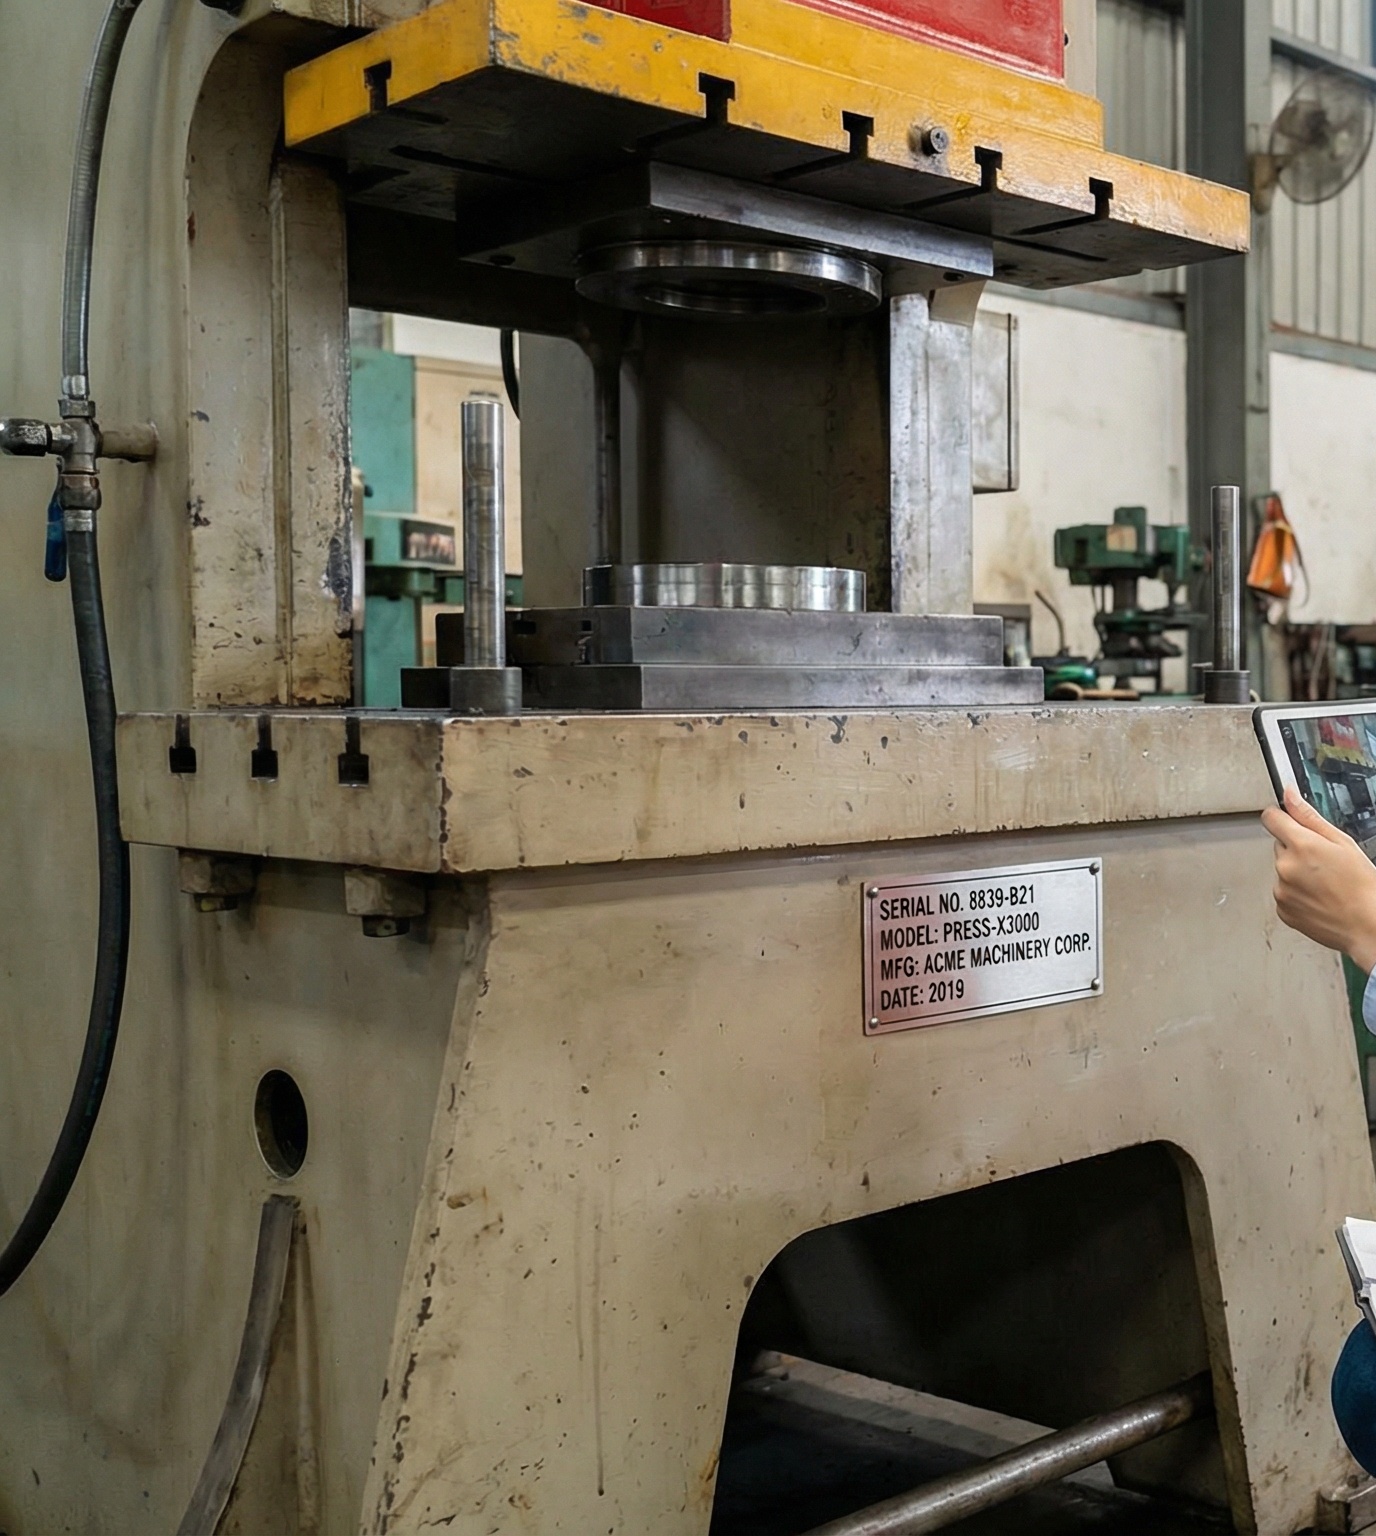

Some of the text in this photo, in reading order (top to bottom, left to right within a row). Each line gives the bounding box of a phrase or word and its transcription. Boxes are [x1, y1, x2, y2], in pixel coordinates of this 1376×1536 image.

[879, 884, 1035, 921] SERIAL NO. 8839-B21
[880, 911, 1040, 951] MODEL: PRESS-X3000
[880, 932, 1092, 981] MFG: ACME MACHINERY CORP.
[880, 978, 965, 1011] DATE: 2019
